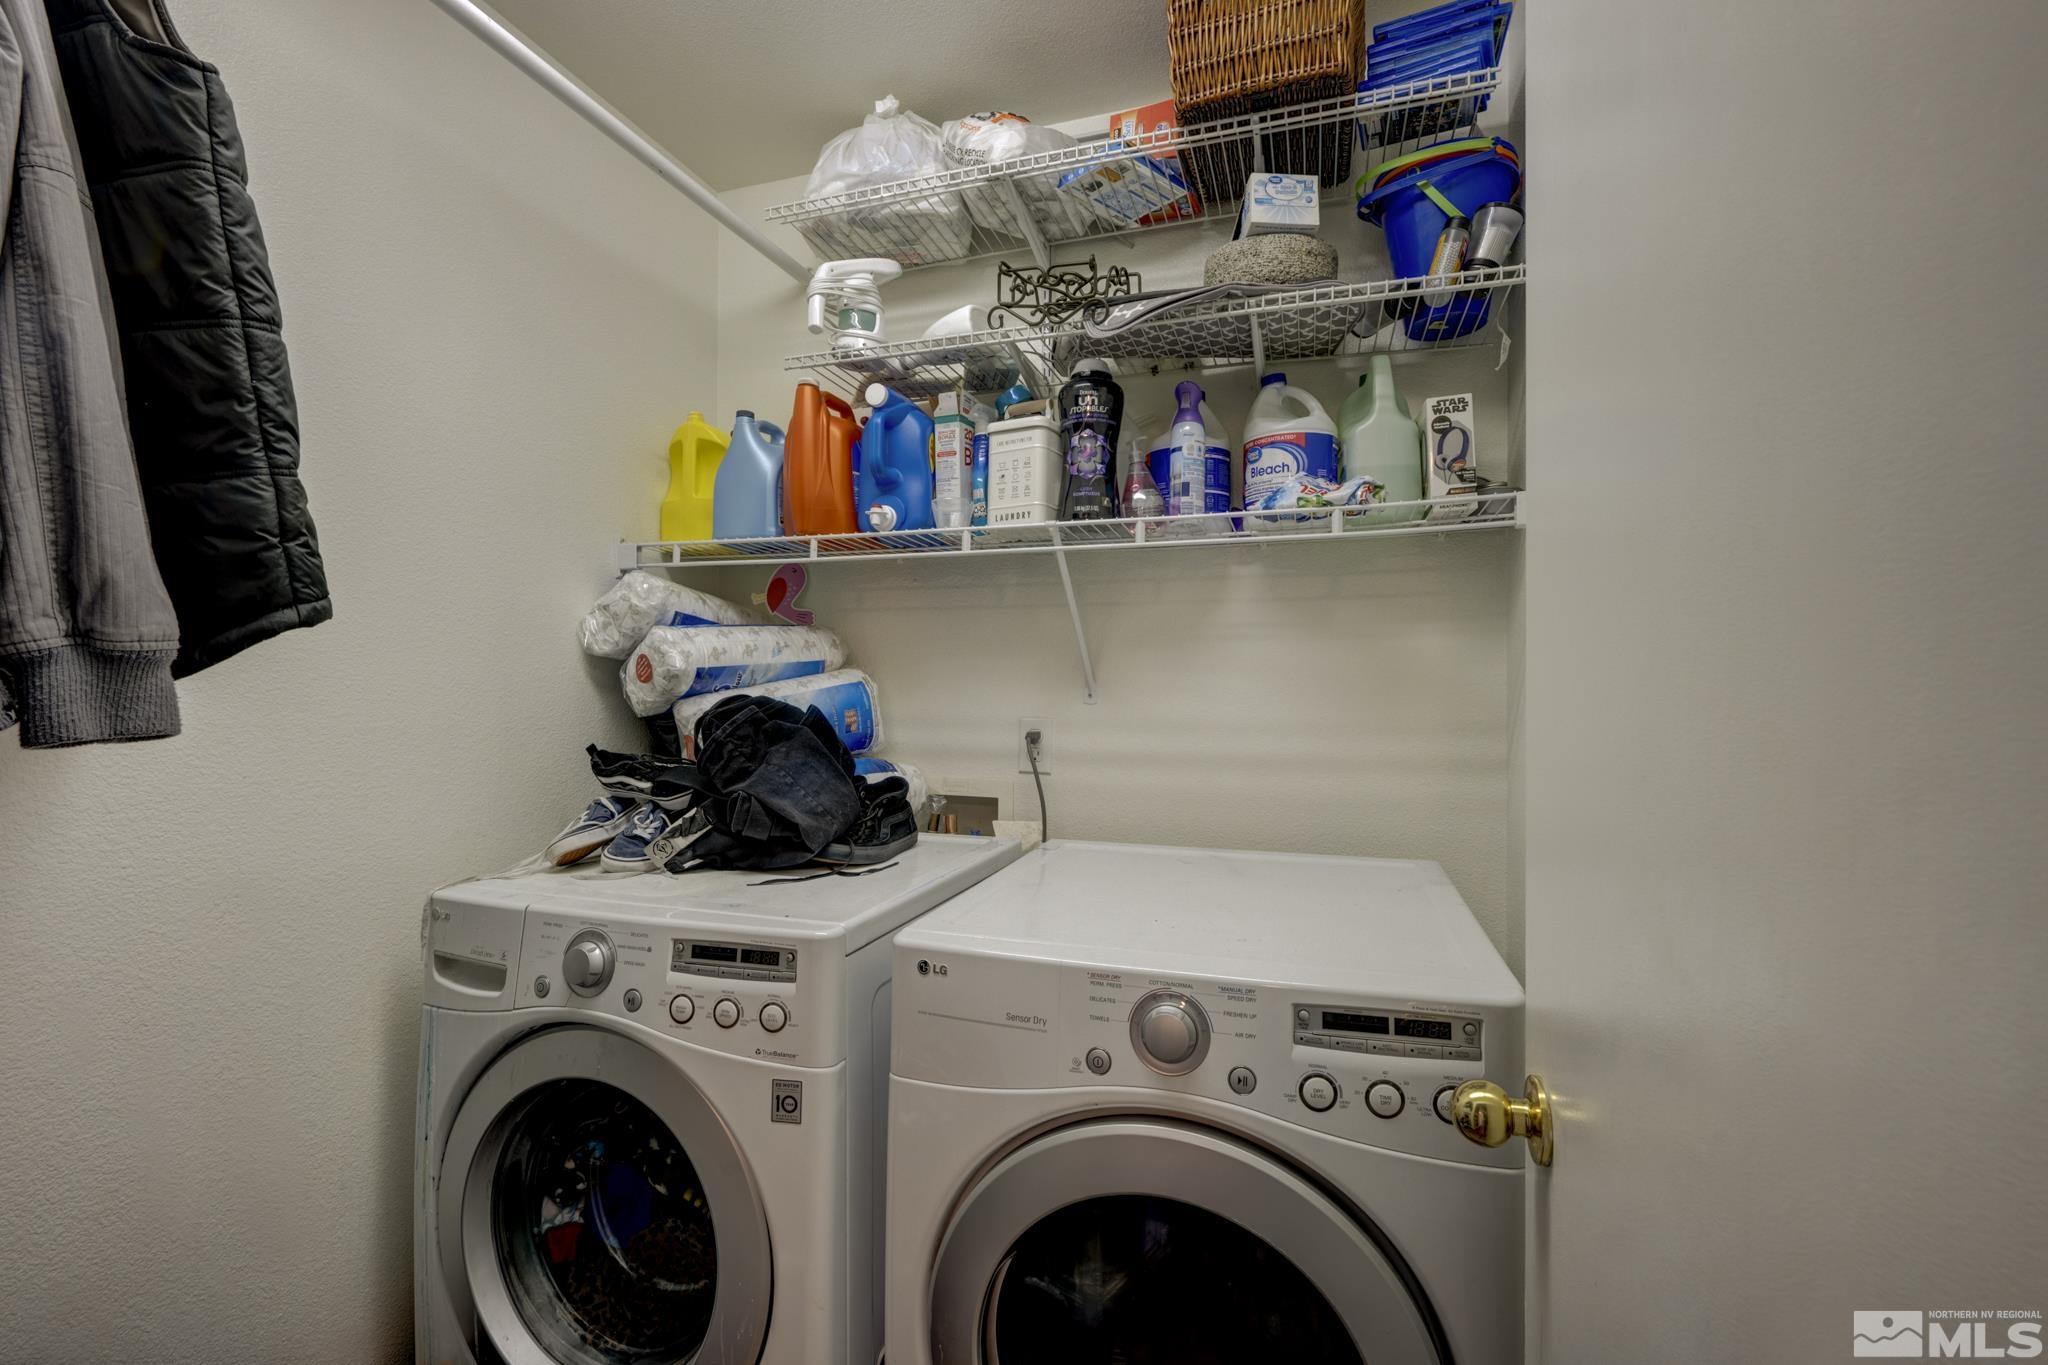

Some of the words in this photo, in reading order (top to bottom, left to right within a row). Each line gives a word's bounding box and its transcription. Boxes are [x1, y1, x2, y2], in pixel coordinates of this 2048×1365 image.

[1432, 397, 1468, 407] STAR
[1432, 404, 1469, 415] WARS
[1251, 462, 1289, 478] Bleach
[995, 511, 1031, 522] LAUNDRY
[933, 964, 948, 976] LG
[1089, 996, 1116, 1004] DELICATES
[1006, 1012, 1031, 1023] Sensor
[1033, 1015, 1047, 1027] Dry
[776, 1095, 798, 1113] 10
